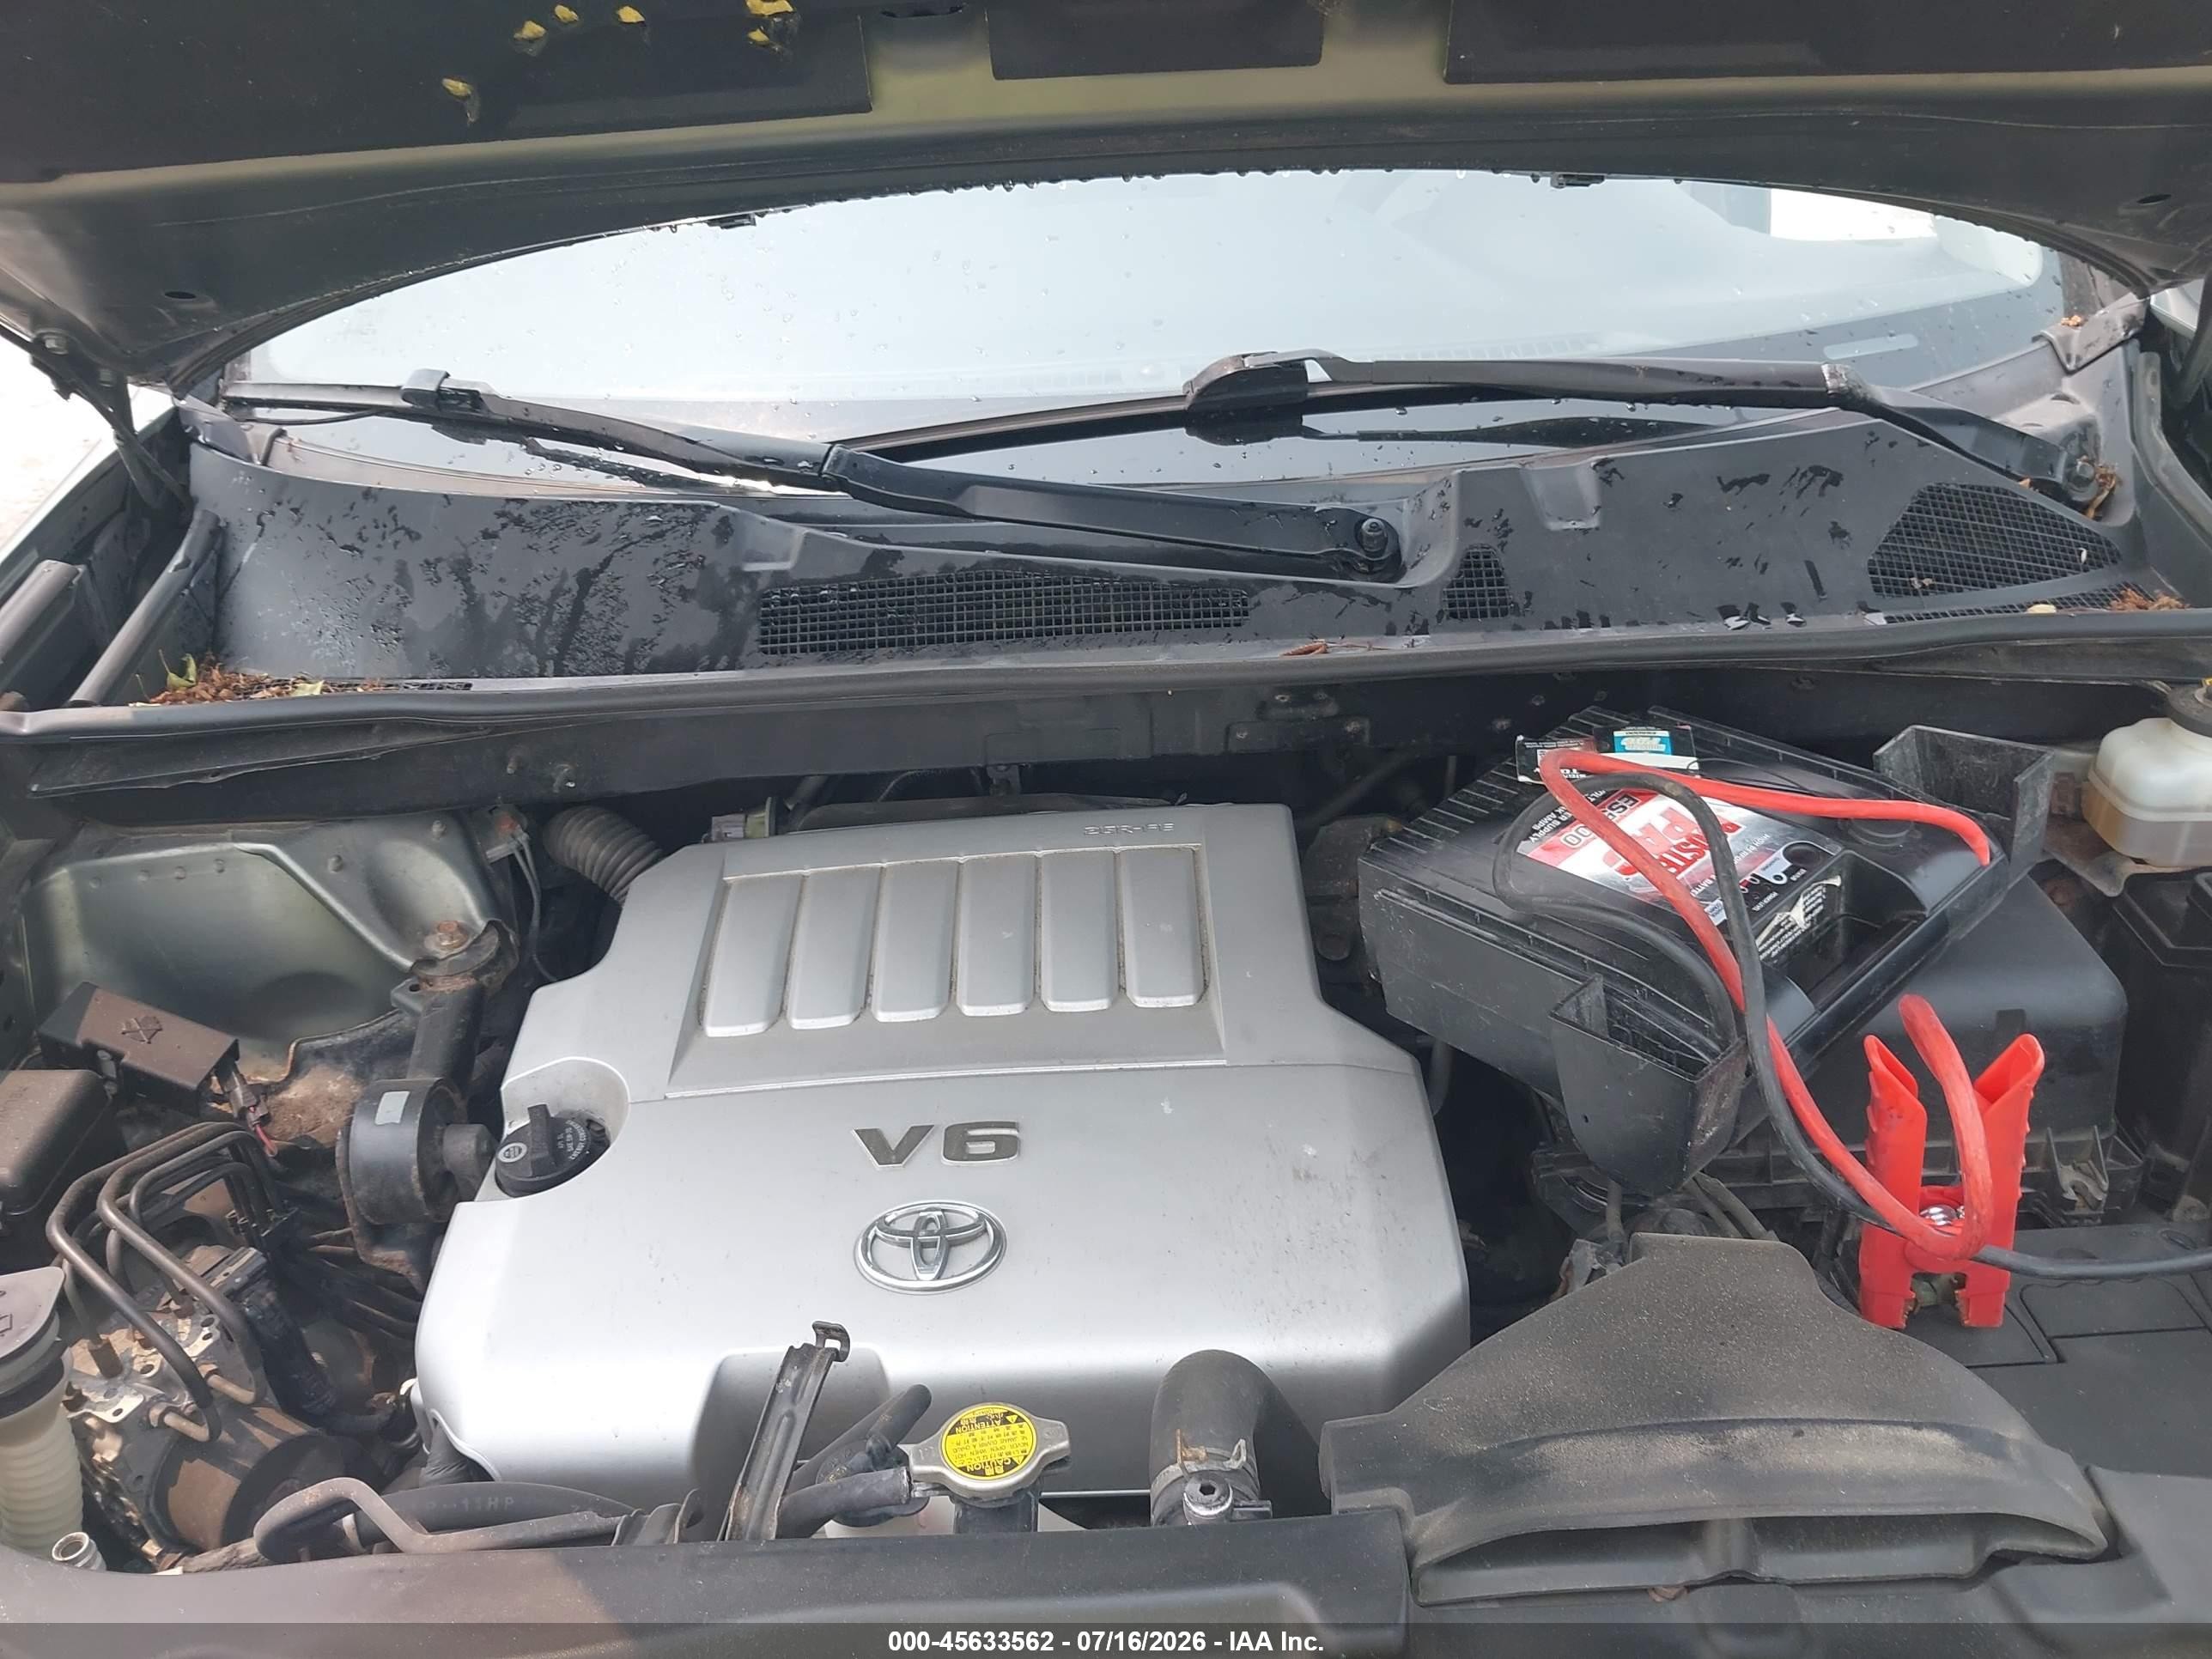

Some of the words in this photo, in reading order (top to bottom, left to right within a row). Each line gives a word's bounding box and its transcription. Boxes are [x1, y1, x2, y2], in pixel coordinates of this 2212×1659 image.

[852, 1121, 1020, 1167] V6
[956, 1419, 1000, 1433] ATTENTION
[967, 1458, 1012, 1472] CAUTION
